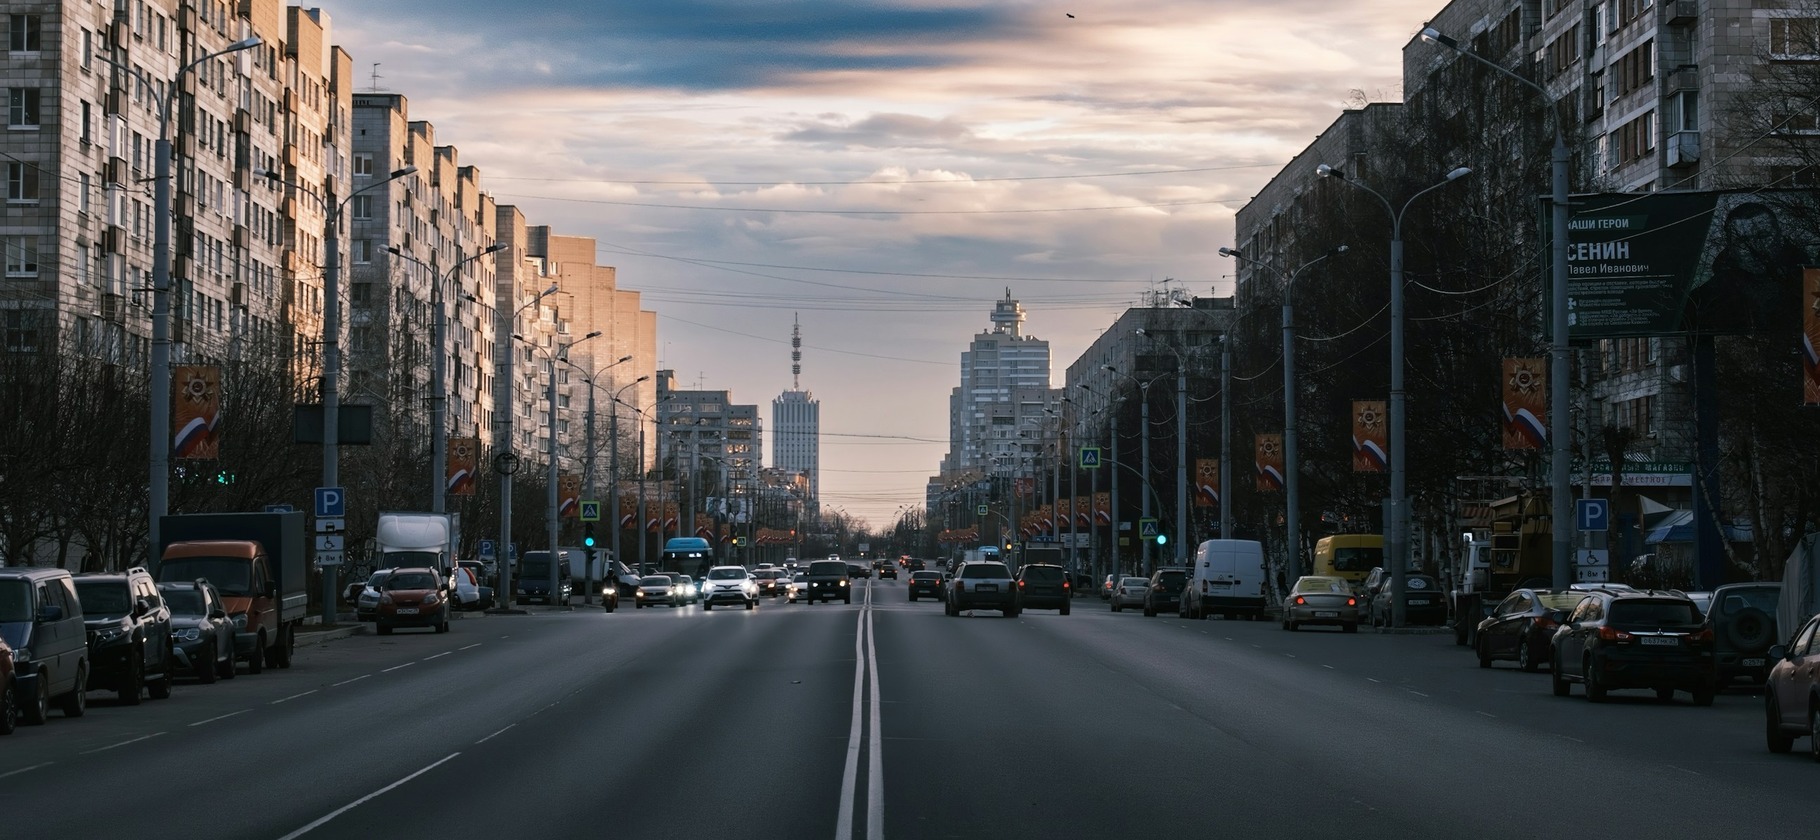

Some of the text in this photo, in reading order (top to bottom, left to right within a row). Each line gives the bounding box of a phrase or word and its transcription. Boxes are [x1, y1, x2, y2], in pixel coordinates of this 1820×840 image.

[1598, 218, 1629, 229] ГЕРОИ
[1567, 241, 1630, 261] СЕНИН
[1600, 263, 1649, 274] Иванович
[323, 490, 339, 514] P
[1585, 502, 1603, 528] P
